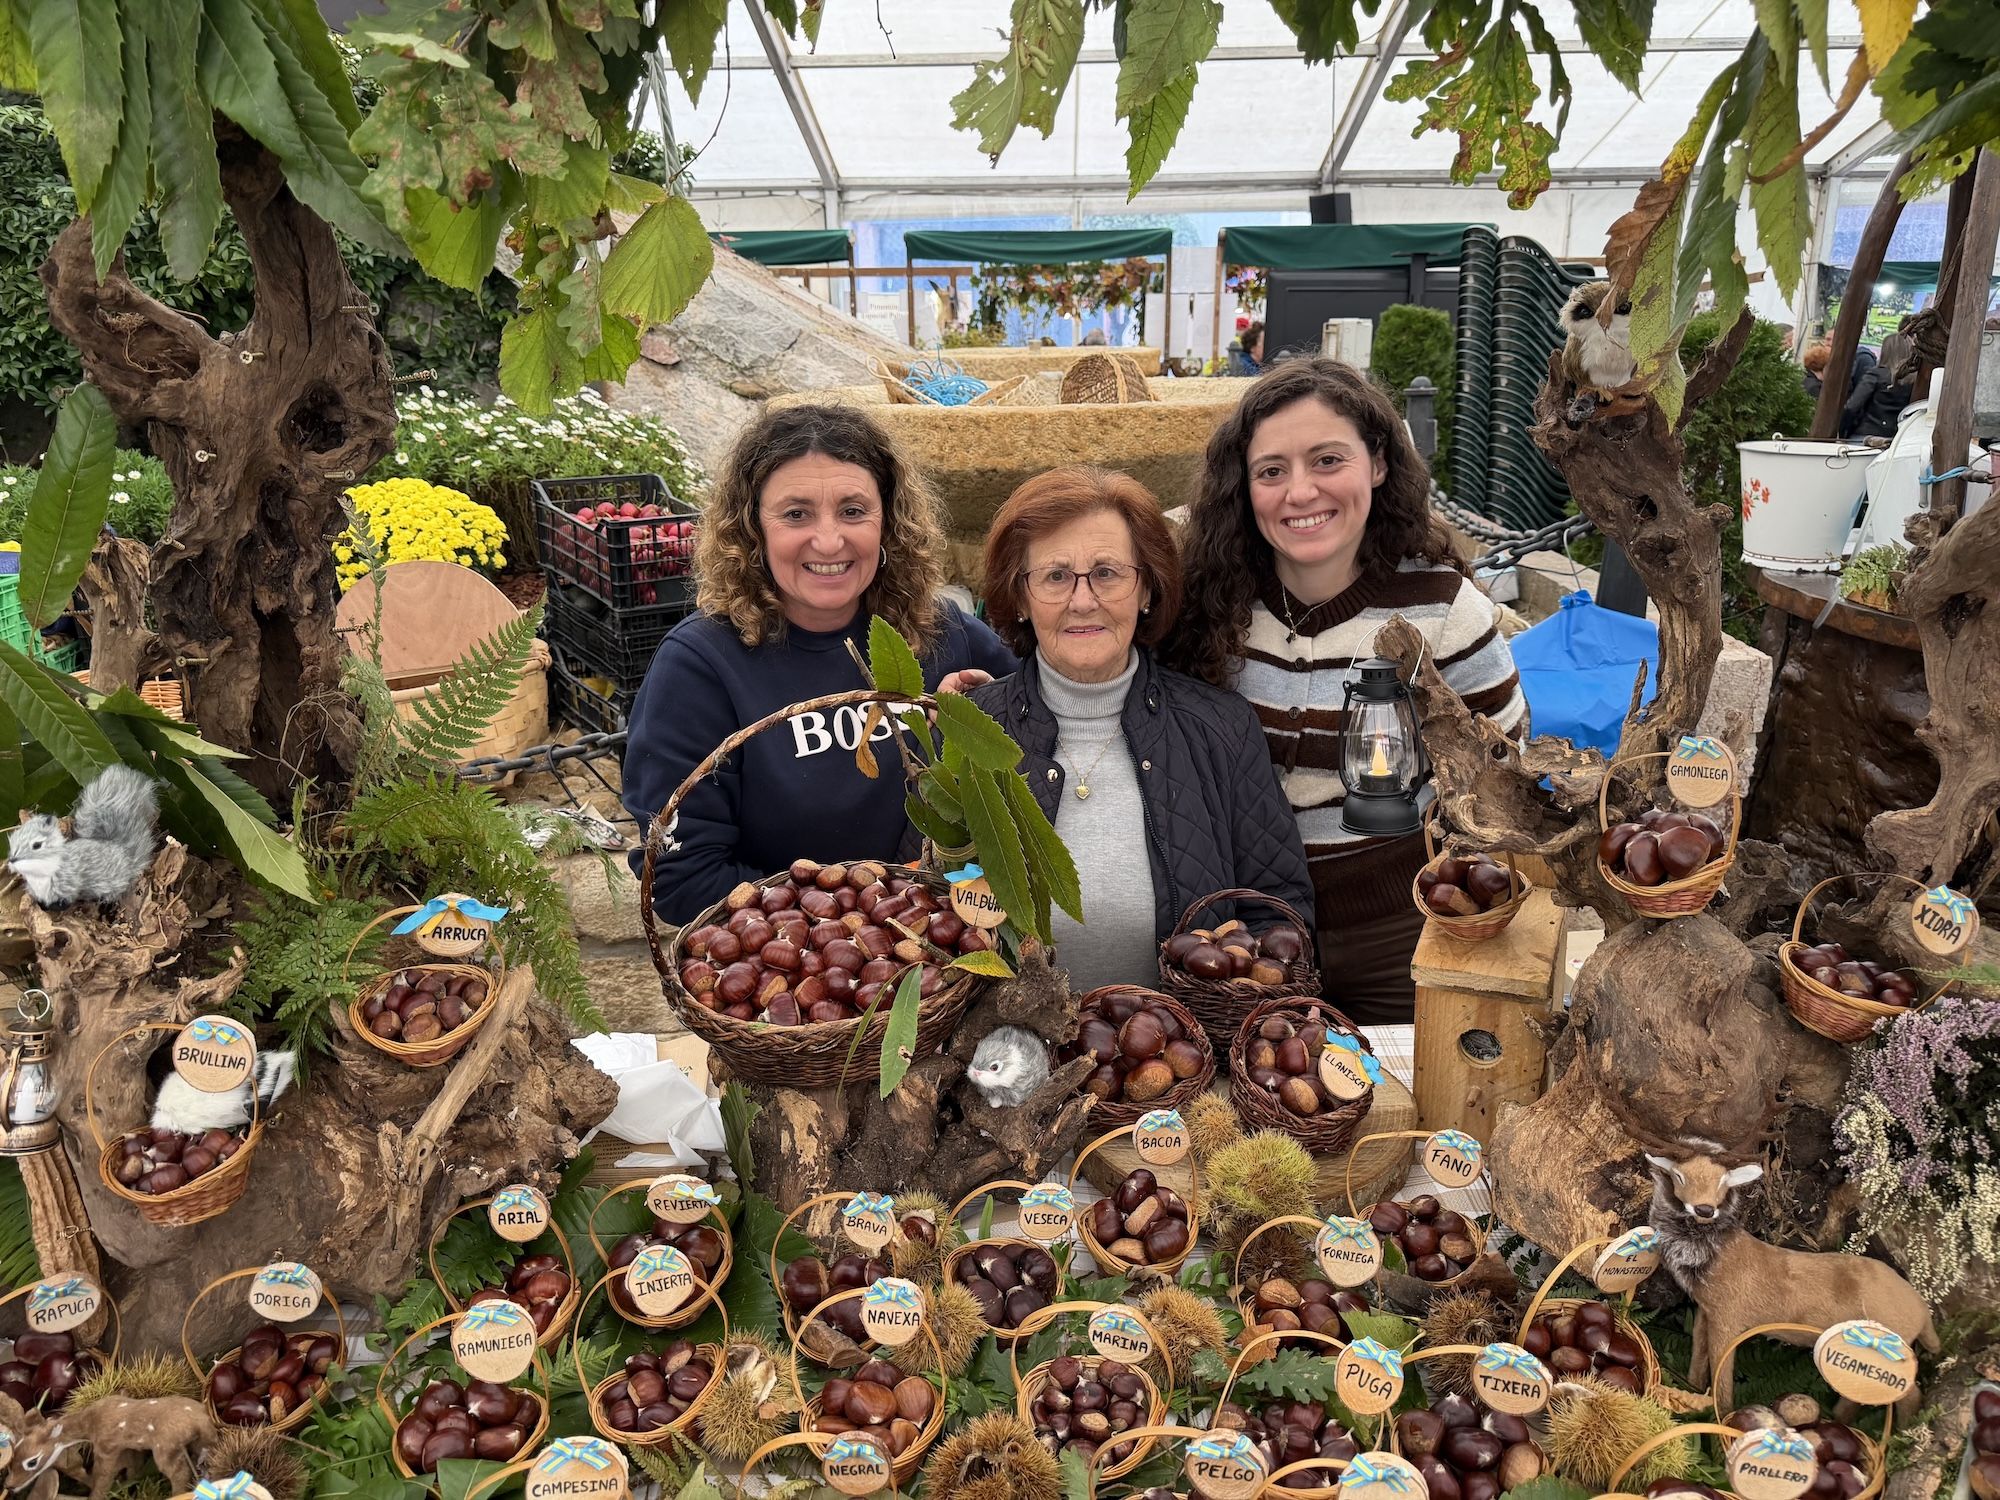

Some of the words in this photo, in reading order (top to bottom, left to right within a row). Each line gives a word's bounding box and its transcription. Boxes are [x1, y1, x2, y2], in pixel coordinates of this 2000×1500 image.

[1670, 765, 1729, 781] GAMONIEGA
[421, 926, 487, 941] ARRUCA
[1914, 904, 1962, 945] XIDRA
[177, 1046, 247, 1071] BRULLINA
[1324, 1053, 1366, 1089] LLANISCA
[1140, 1135, 1181, 1149] BACOA
[1431, 1149, 1472, 1177] FANO
[653, 1198, 712, 1211] REVIERTA
[498, 1210, 543, 1225] ARIAL
[845, 1215, 888, 1235] BRAVA
[1024, 1212, 1068, 1226] VESECA
[1322, 1246, 1374, 1264] FORNIEGA
[1625, 1254, 1638, 1263] EL
[1602, 1266, 1653, 1276] MONASTERIO
[635, 1272, 692, 1297] INJERTA
[253, 1292, 311, 1308] DORIGA
[33, 1297, 96, 1325] RAPUCA
[867, 1308, 921, 1326] NAVEXA
[457, 1332, 533, 1358] RAMUNIEGA
[1091, 1330, 1148, 1353] MARINA
[1825, 1347, 1907, 1392] VEGAMESADA
[1345, 1363, 1393, 1399] PUGA
[1479, 1374, 1541, 1399] TIXERA
[829, 1464, 884, 1477] NEGRAL
[1194, 1461, 1255, 1482] PELGO
[1739, 1462, 1809, 1484] PARLLERA
[531, 1477, 618, 1498] CAMPESINA
